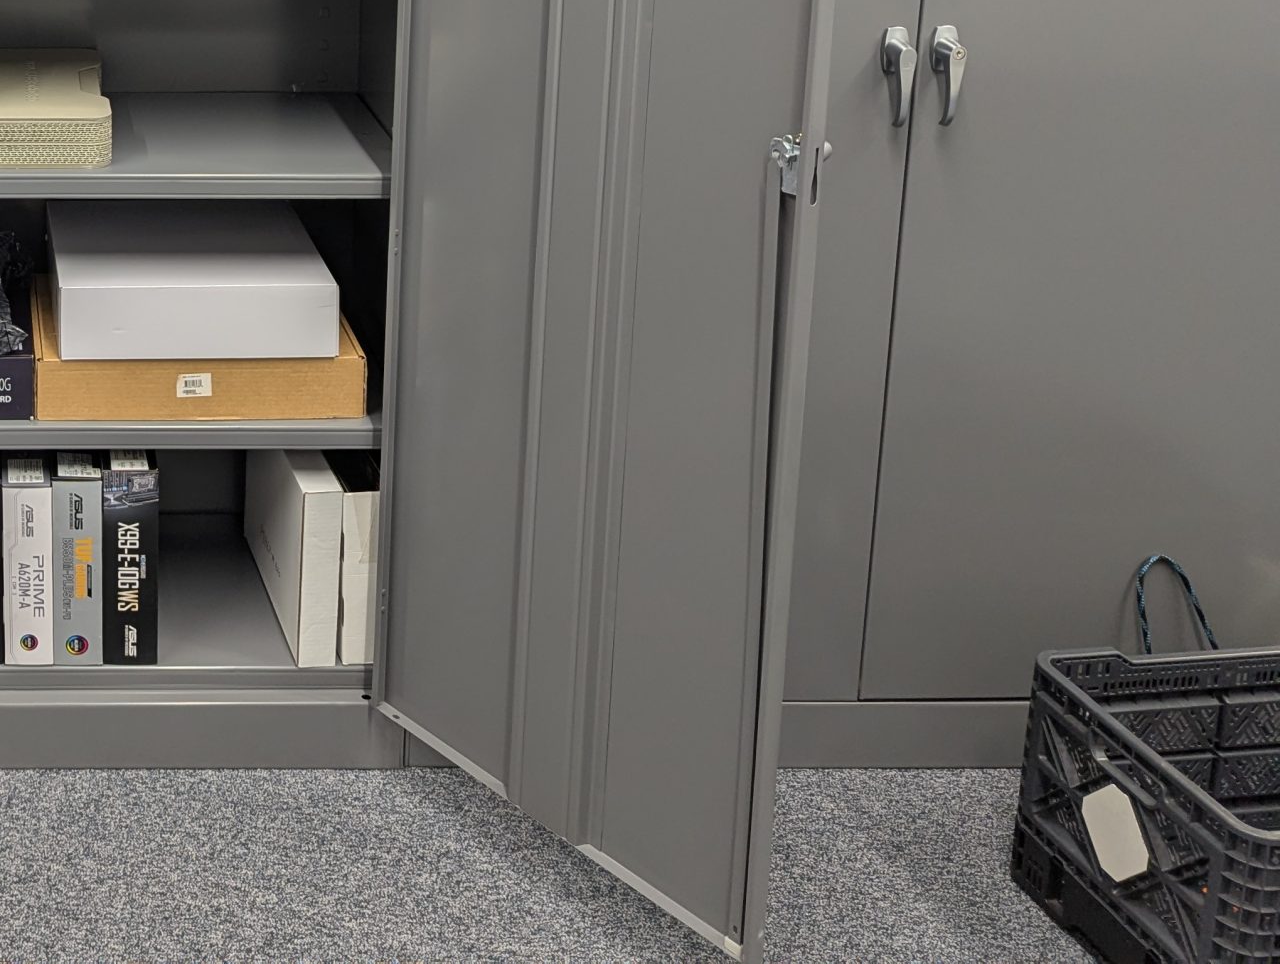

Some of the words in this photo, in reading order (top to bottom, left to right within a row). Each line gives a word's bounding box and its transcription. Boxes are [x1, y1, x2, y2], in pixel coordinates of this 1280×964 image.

[25, 504, 34, 538] ASUS
[74, 493, 83, 530] ASUS
[118, 522, 140, 589] X99-E-10G
[18, 562, 31, 609] A620M-A
[33, 554, 45, 618] PRIME
[118, 590, 140, 612] WS
[127, 625, 137, 658] ASUS
